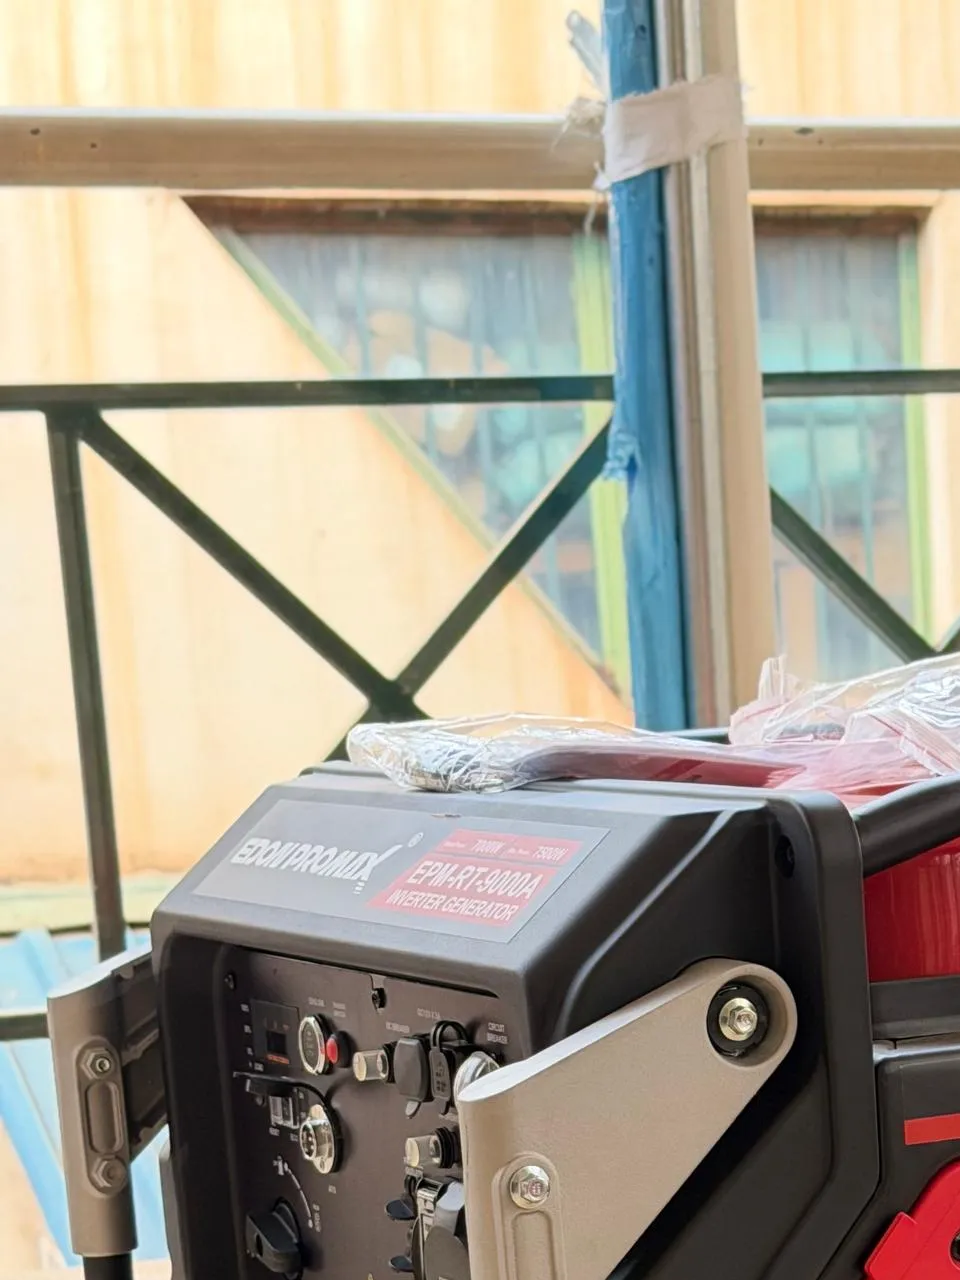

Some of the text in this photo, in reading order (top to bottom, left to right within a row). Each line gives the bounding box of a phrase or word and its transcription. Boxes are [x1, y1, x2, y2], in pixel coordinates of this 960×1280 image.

[230, 838, 402, 894] EDON PROMAX
[407, 860, 543, 899] EPM-RT-9000A
[386, 889, 519, 921] INVERTER GENERATOR
